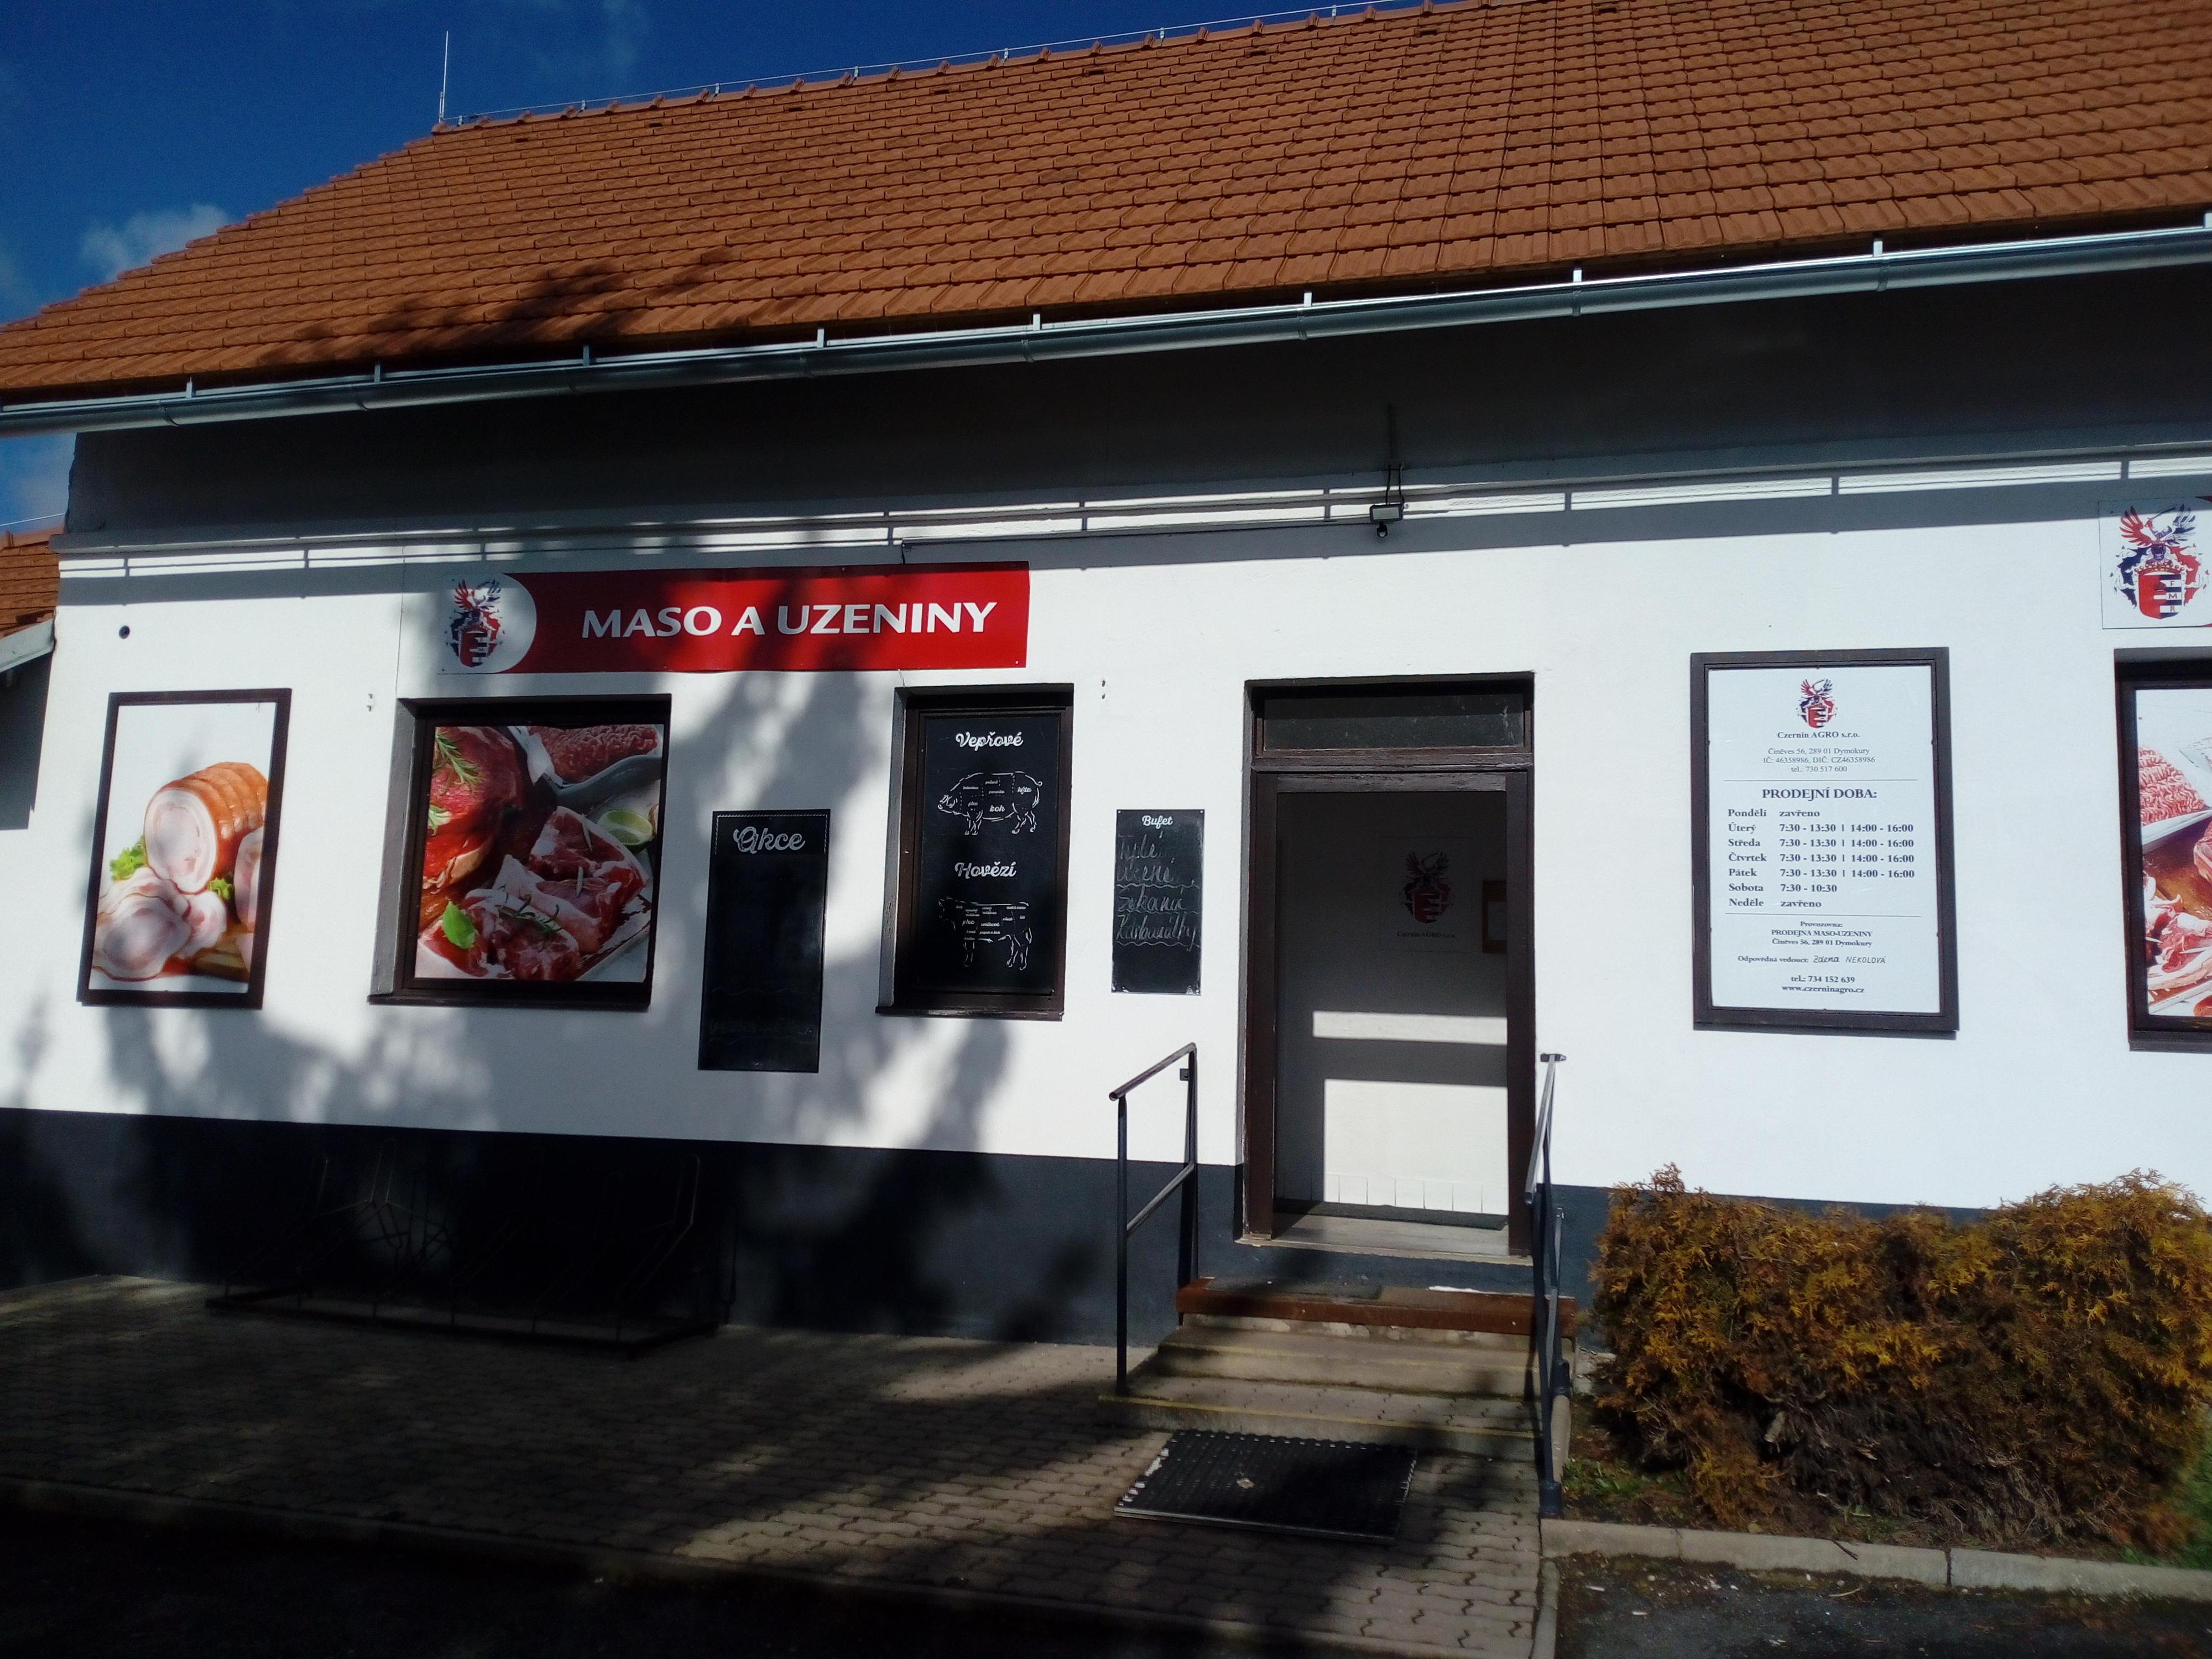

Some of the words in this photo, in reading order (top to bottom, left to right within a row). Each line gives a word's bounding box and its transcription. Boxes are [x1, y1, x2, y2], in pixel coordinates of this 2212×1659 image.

[582, 606, 722, 638] MASO
[731, 607, 764, 635] A
[779, 602, 997, 634] UZENINY
[956, 732, 1023, 751] Vepřové
[1762, 787, 1829, 801] PRODEJNÍ
[1834, 789, 1876, 798] DOBA:
[1142, 815, 1173, 829] Bufet
[1729, 822, 1756, 834] Úterý
[733, 827, 805, 854] Akce
[1729, 852, 1767, 861] Čtvrtek
[955, 862, 1016, 879] Hovězí
[1729, 898, 1764, 906] Neděle
[1782, 986, 1864, 994] www.czerninagro.cz
